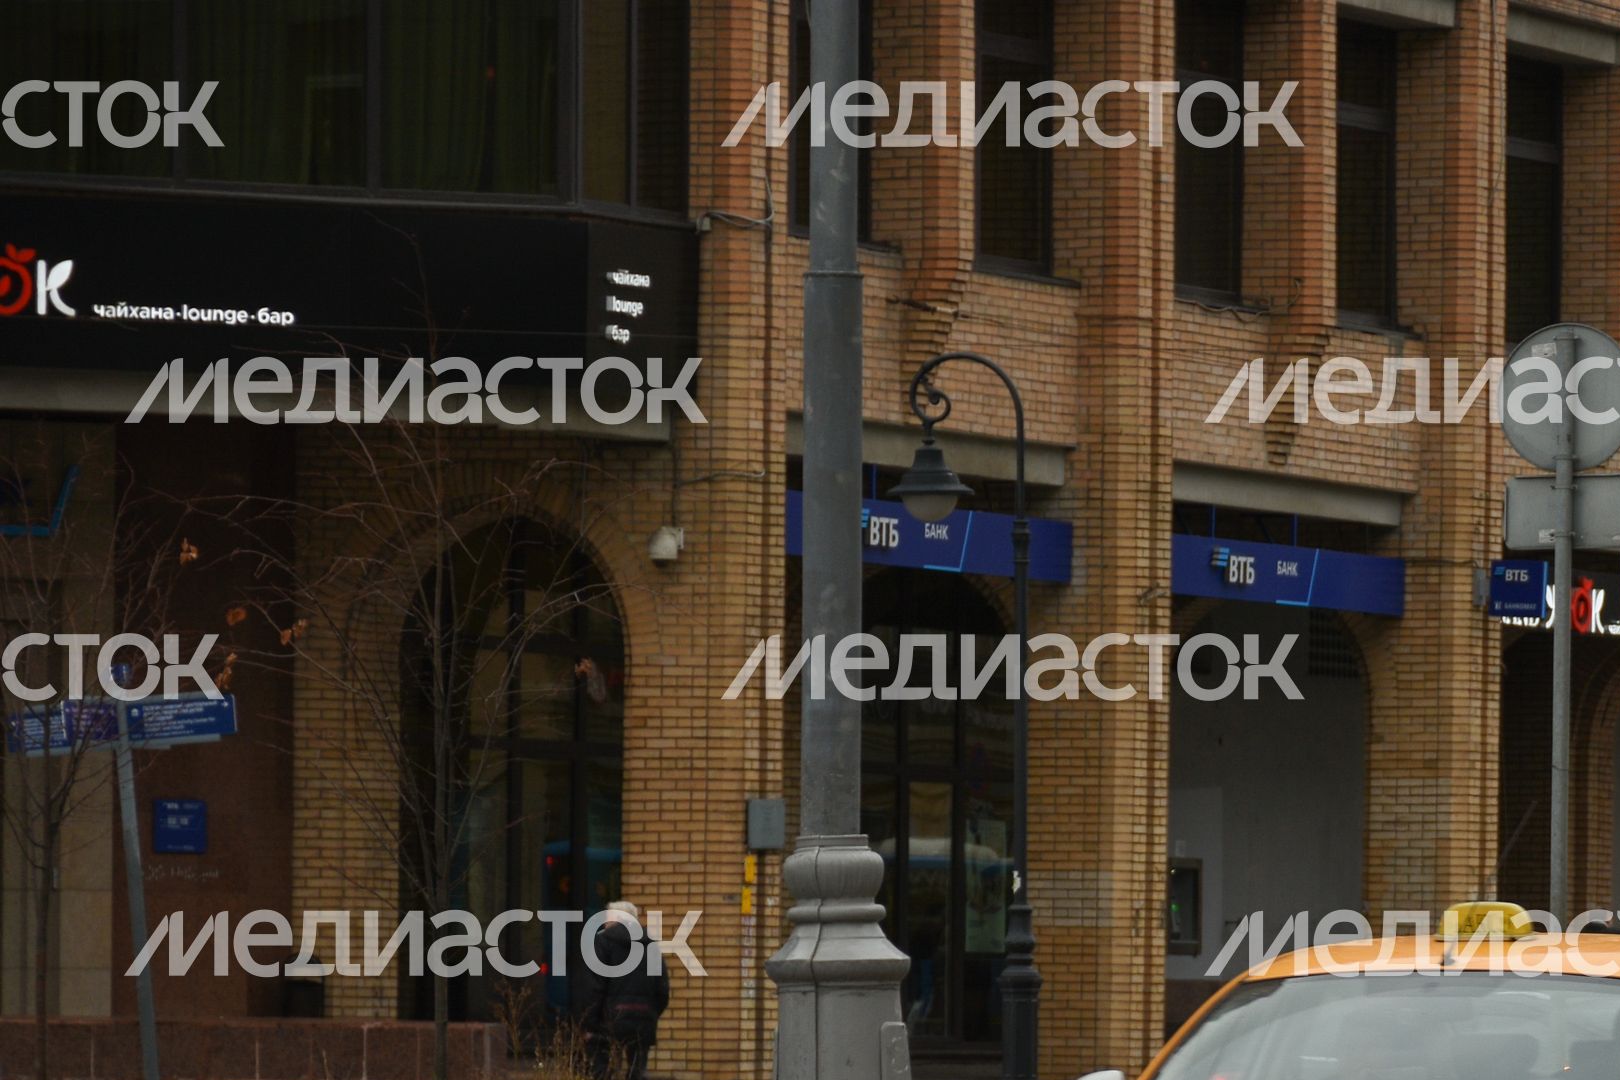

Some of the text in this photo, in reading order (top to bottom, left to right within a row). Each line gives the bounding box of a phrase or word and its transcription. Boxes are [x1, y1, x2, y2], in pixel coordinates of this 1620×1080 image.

[869, 515, 949, 548] ВТБ БАНК
[1228, 555, 1299, 585] ВТБ БАНК
[1504, 568, 1530, 583] ВТБ
